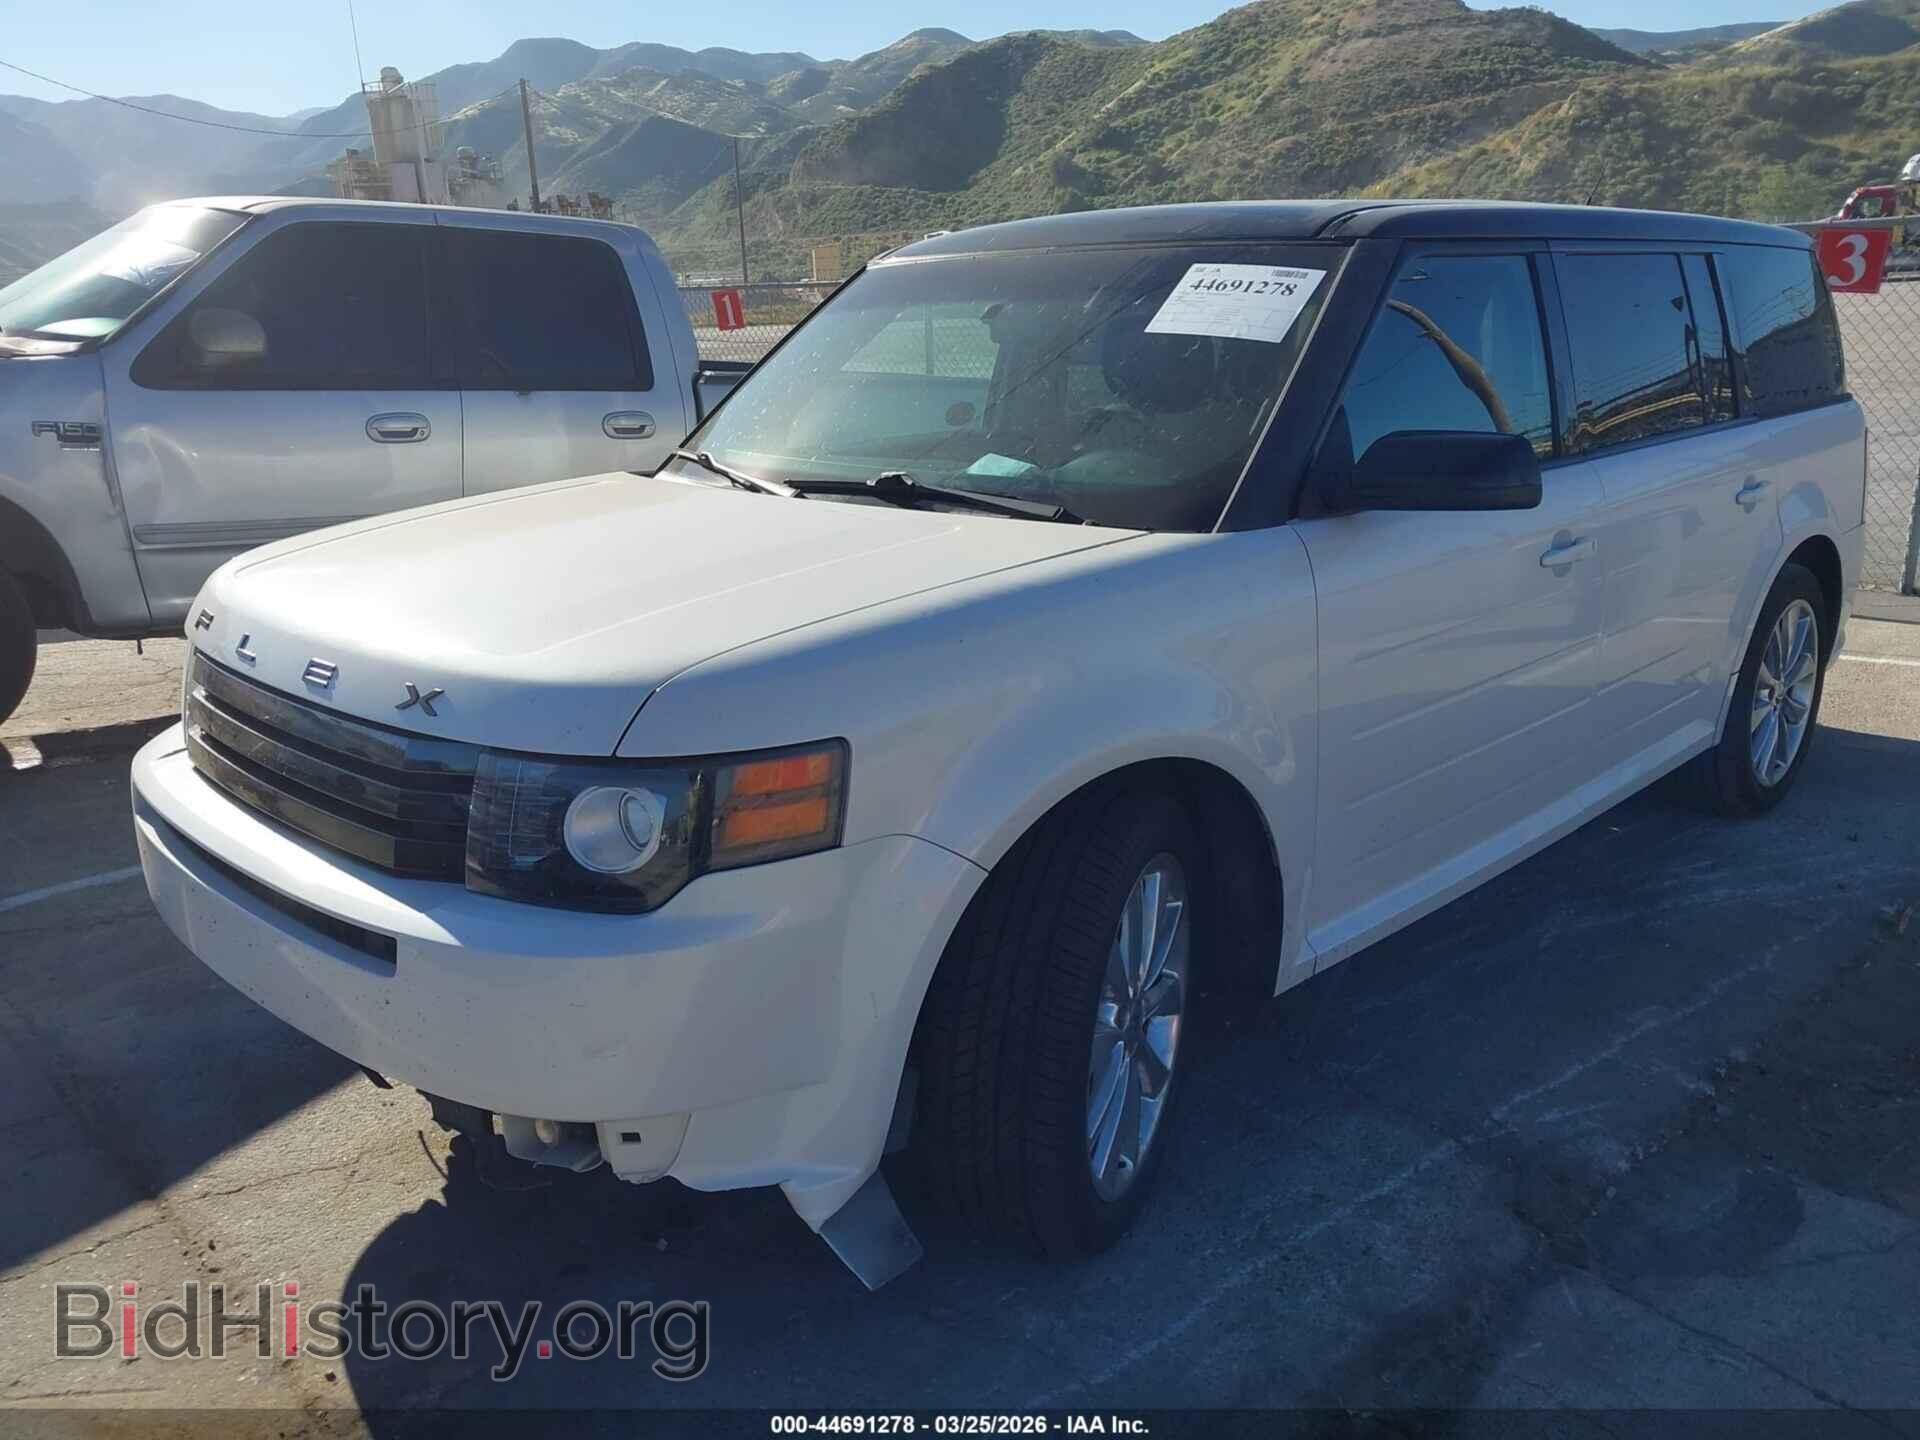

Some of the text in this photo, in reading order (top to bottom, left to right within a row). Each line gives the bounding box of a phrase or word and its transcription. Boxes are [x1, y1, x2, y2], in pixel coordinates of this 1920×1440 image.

[1825, 234, 1868, 286] 3
[1190, 278, 1298, 296] 44691278
[721, 294, 737, 327] 1
[195, 608, 445, 717] FLEX
